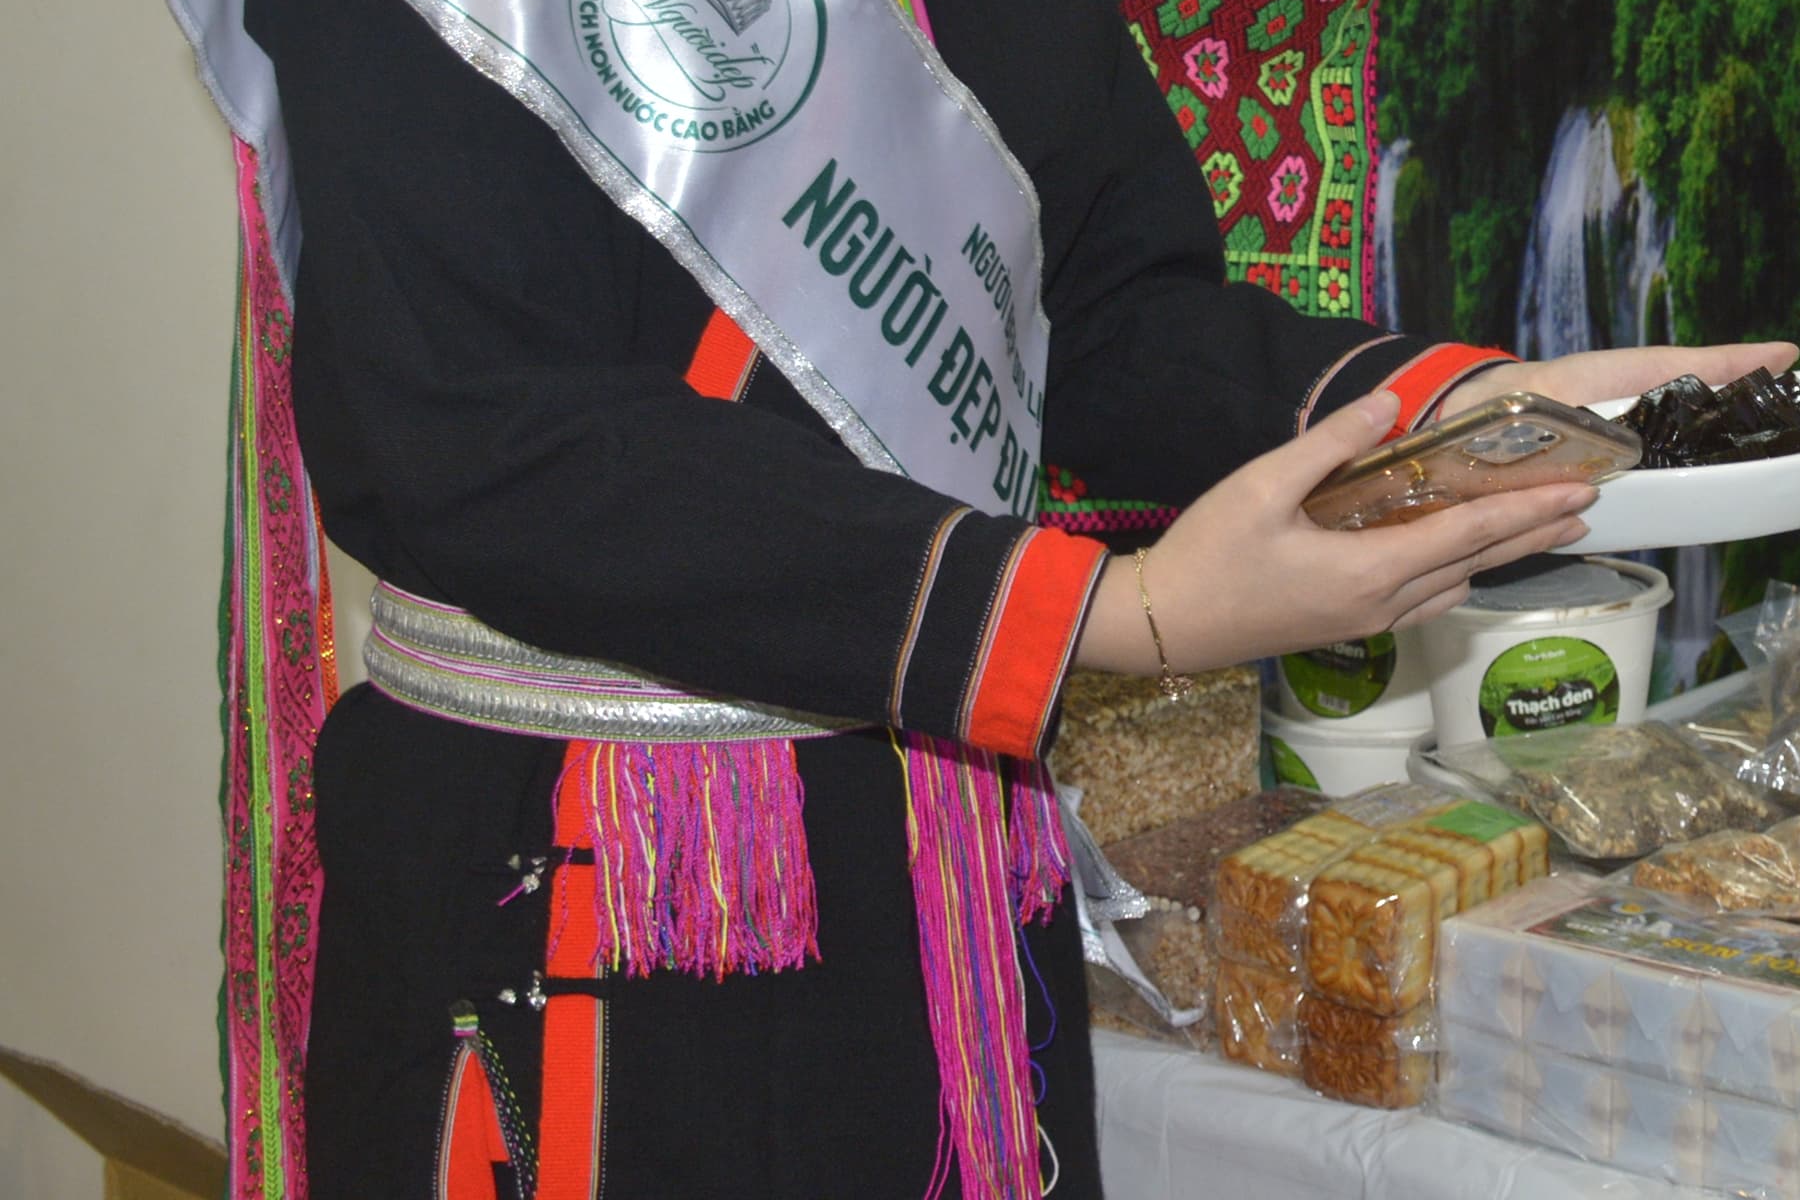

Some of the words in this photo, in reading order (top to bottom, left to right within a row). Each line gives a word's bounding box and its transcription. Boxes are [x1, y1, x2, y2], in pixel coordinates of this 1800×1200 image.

[584, 32, 618, 87] NON
[608, 82, 669, 133] NƯỚC
[671, 117, 720, 141] CAO
[721, 99, 777, 140] BẰNG
[781, 157, 949, 369] NGƯỜI
[926, 324, 1002, 454] ĐẸP
